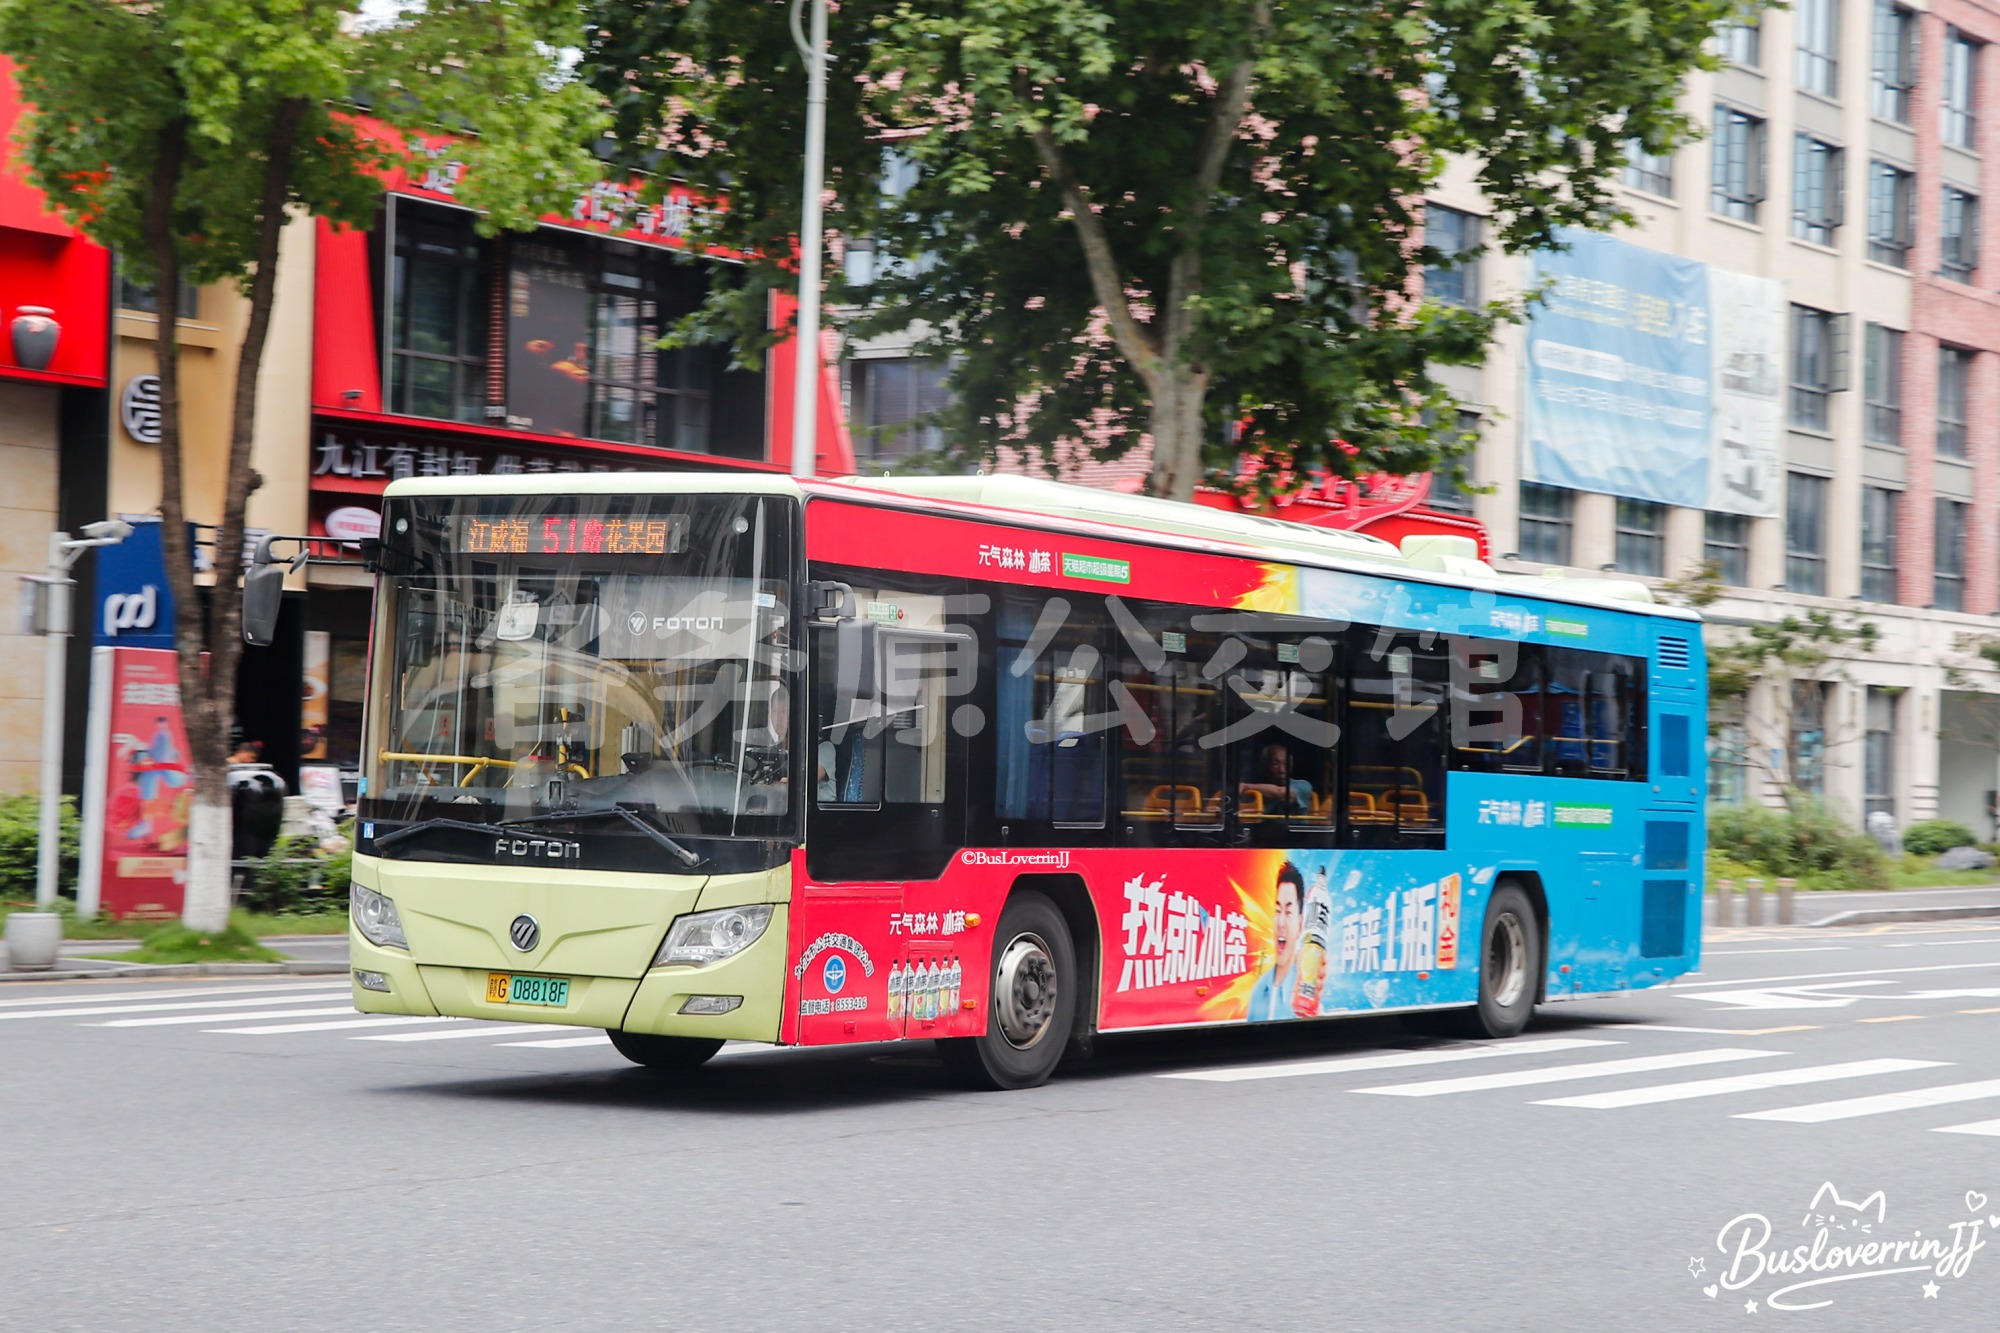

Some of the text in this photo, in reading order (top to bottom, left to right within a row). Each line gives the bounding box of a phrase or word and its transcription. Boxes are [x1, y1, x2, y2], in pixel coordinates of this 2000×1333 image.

[470, 517, 667, 553] 江威福 51路 花果园
[979, 544, 1026, 571] 元气森林
[1028, 549, 1051, 574] 冰茶
[652, 616, 724, 630] FOTON
[495, 838, 581, 859] FOTON
[889, 909, 966, 936] 元气森林 冰茶
[1116, 872, 1249, 993] 热就冰茶
[1340, 882, 1437, 974] 再来1瓶
[794, 931, 875, 981] 九江市公共交通集团公司
